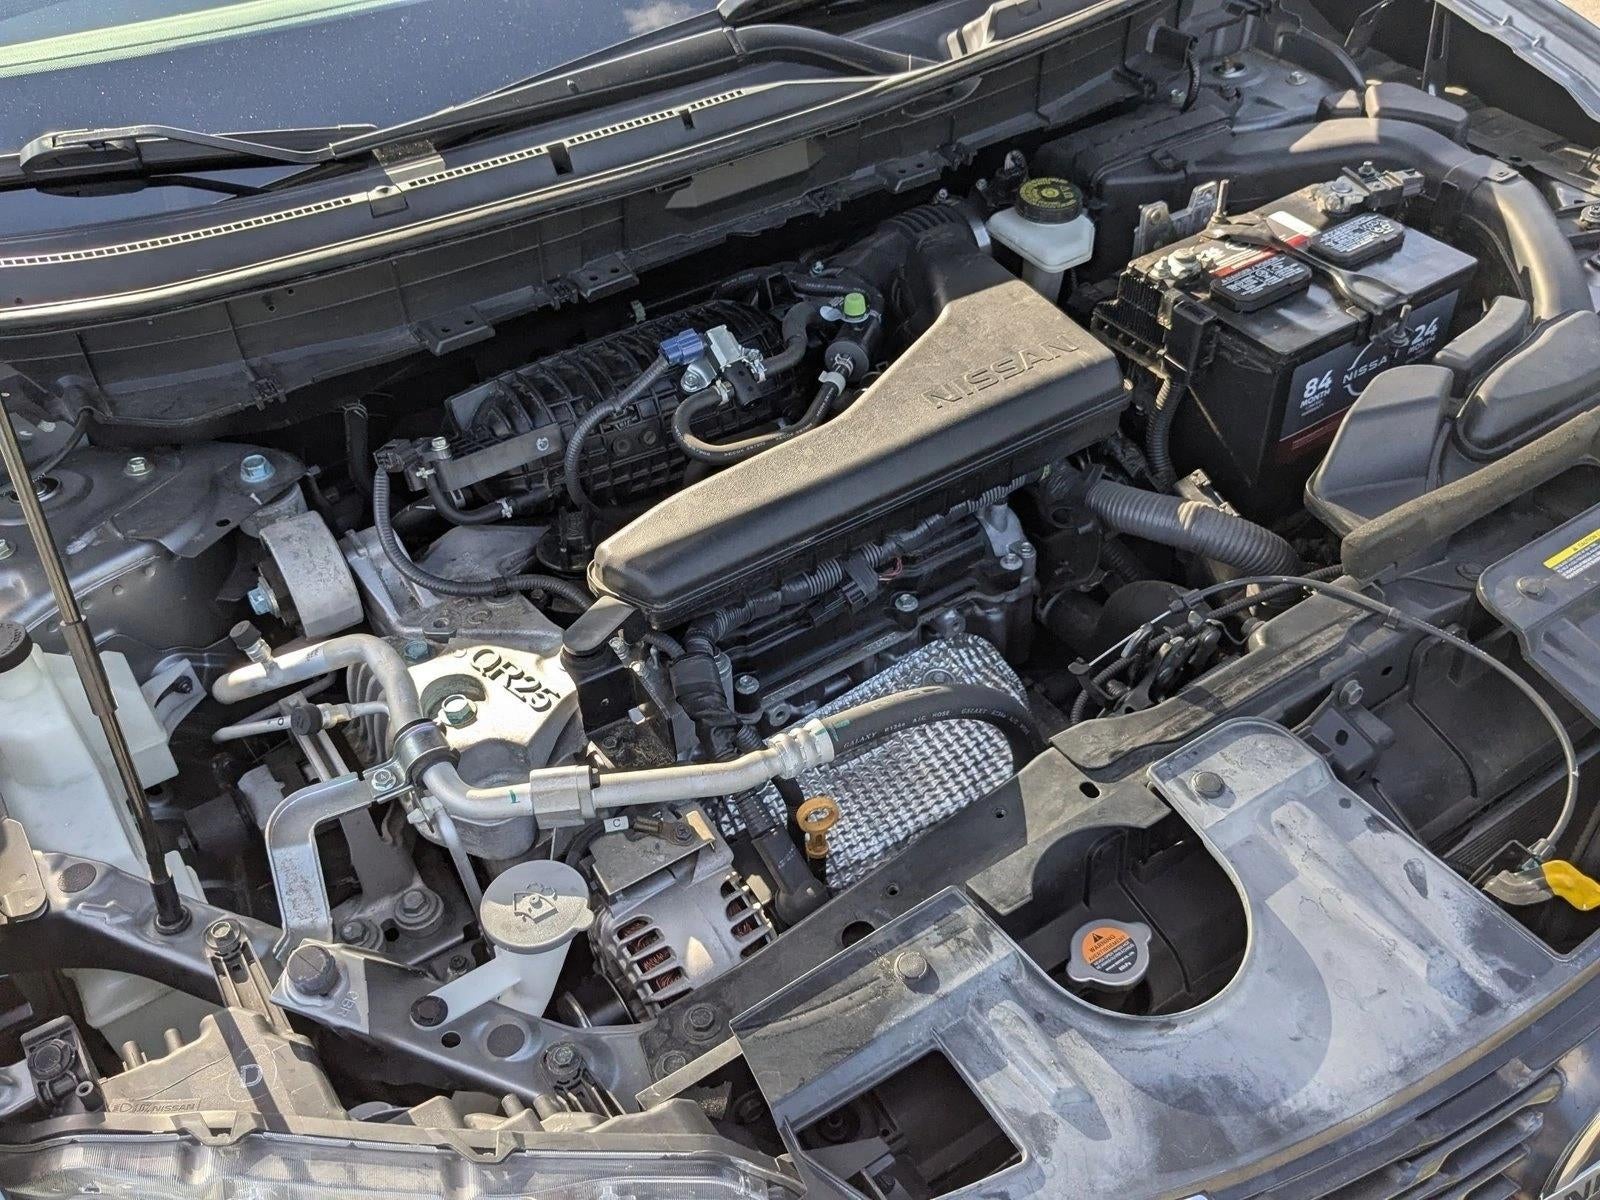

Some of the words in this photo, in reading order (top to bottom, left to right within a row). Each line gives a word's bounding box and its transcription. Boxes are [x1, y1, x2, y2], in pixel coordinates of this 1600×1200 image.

[1411, 316, 1440, 346] 24
[1407, 334, 1436, 354] MONTH
[920, 334, 1079, 410] NISSAN
[1303, 369, 1333, 399] 84
[1300, 388, 1331, 409] MONTH
[470, 648, 561, 713] QR25
[843, 731, 877, 749] GALAXY
[1089, 935, 1115, 952] WARNING
[151, 1102, 195, 1112] NISSAN
